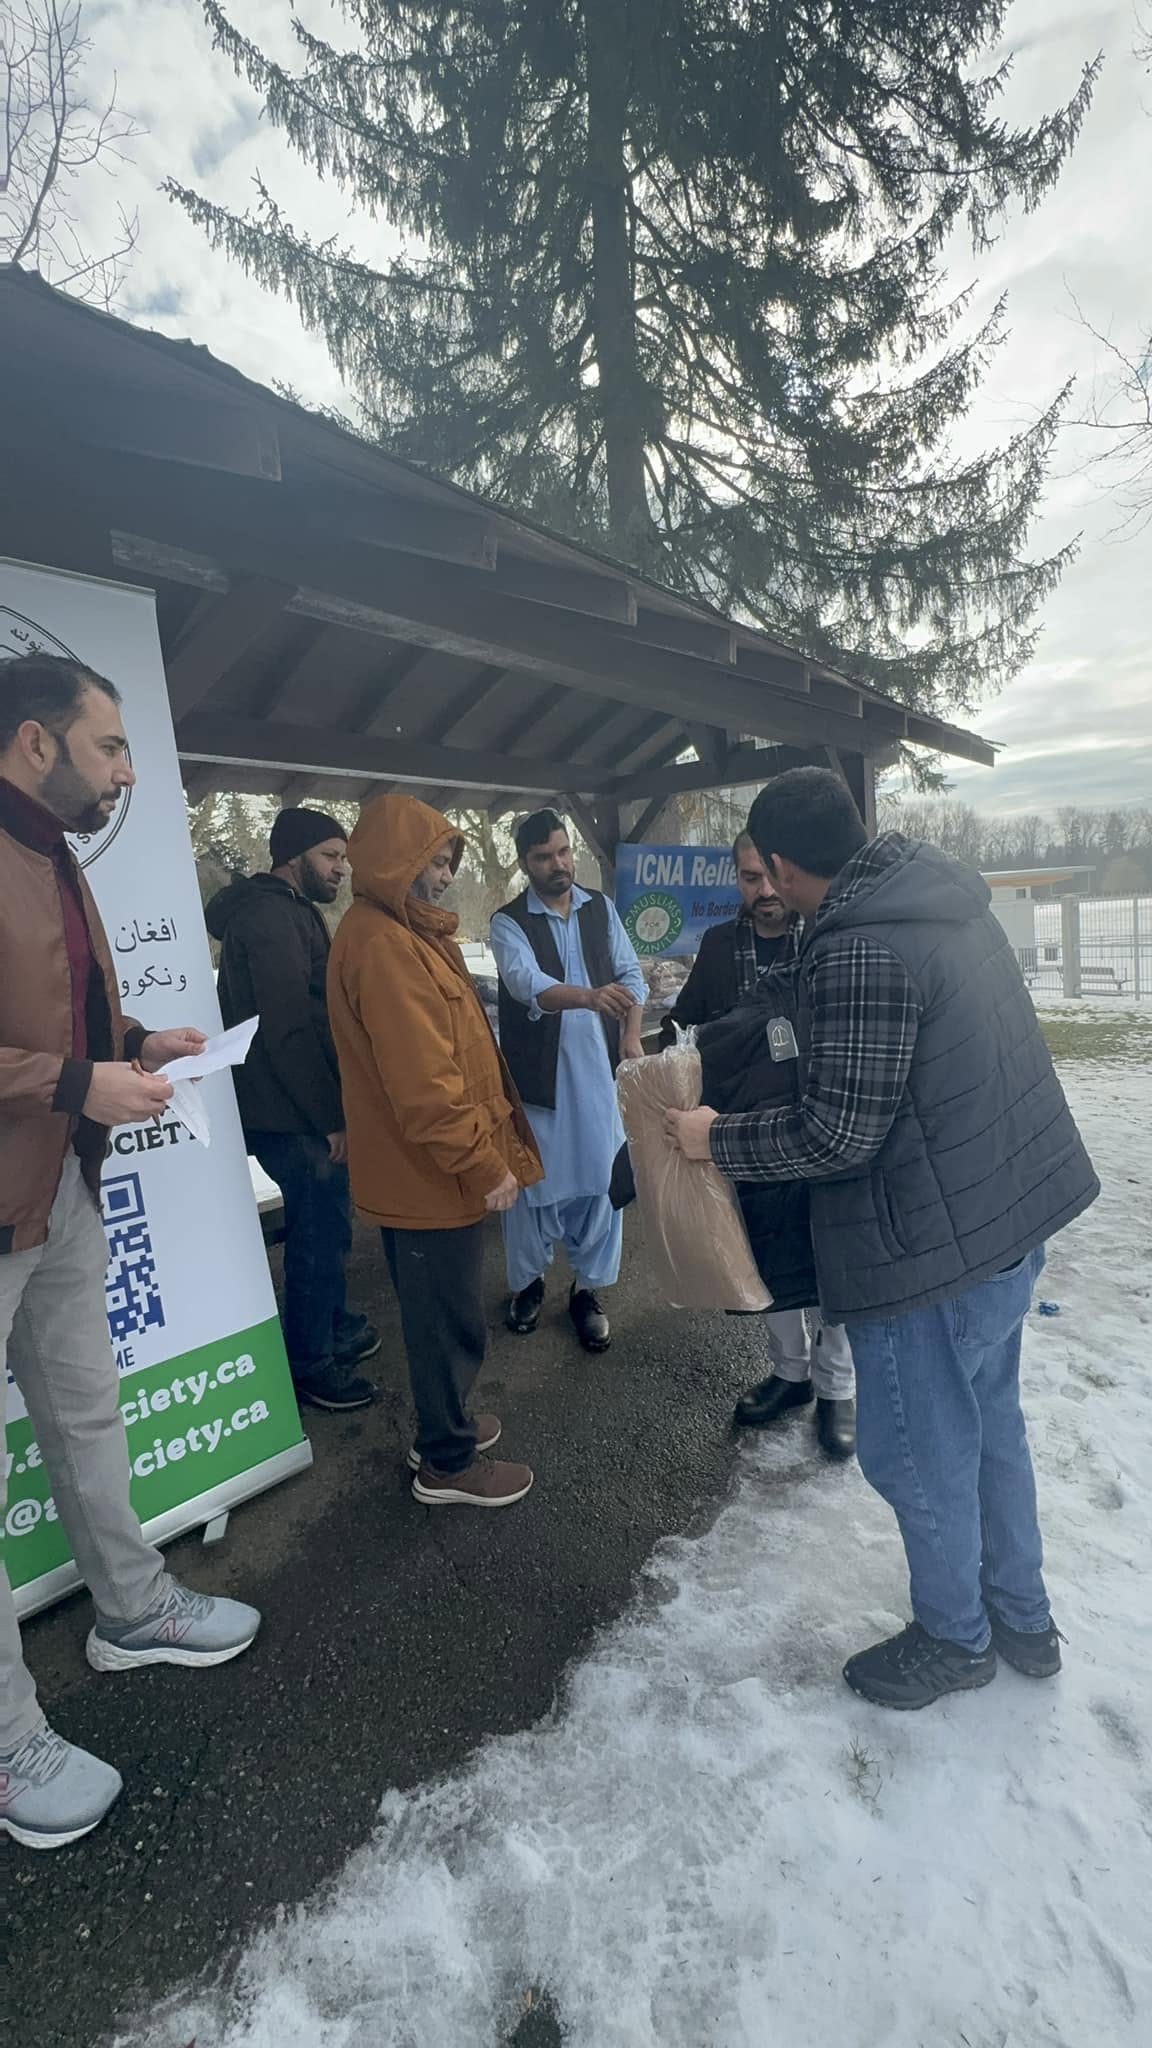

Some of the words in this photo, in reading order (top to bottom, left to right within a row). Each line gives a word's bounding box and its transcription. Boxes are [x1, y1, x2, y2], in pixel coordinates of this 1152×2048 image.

[634, 854, 684, 886] ICNA
[690, 856, 737, 887] Relie
[628, 894, 681, 918] MUSLIMS
[691, 901, 704, 918] No
[707, 901, 738, 917] Border
[115, 917, 177, 953] افغان
[119, 965, 187, 999] ونکوو
[105, 1121, 196, 1159] CIET
[120, 1353, 257, 1426] ciety.ca
[129, 1400, 270, 1480] ciety.ca
